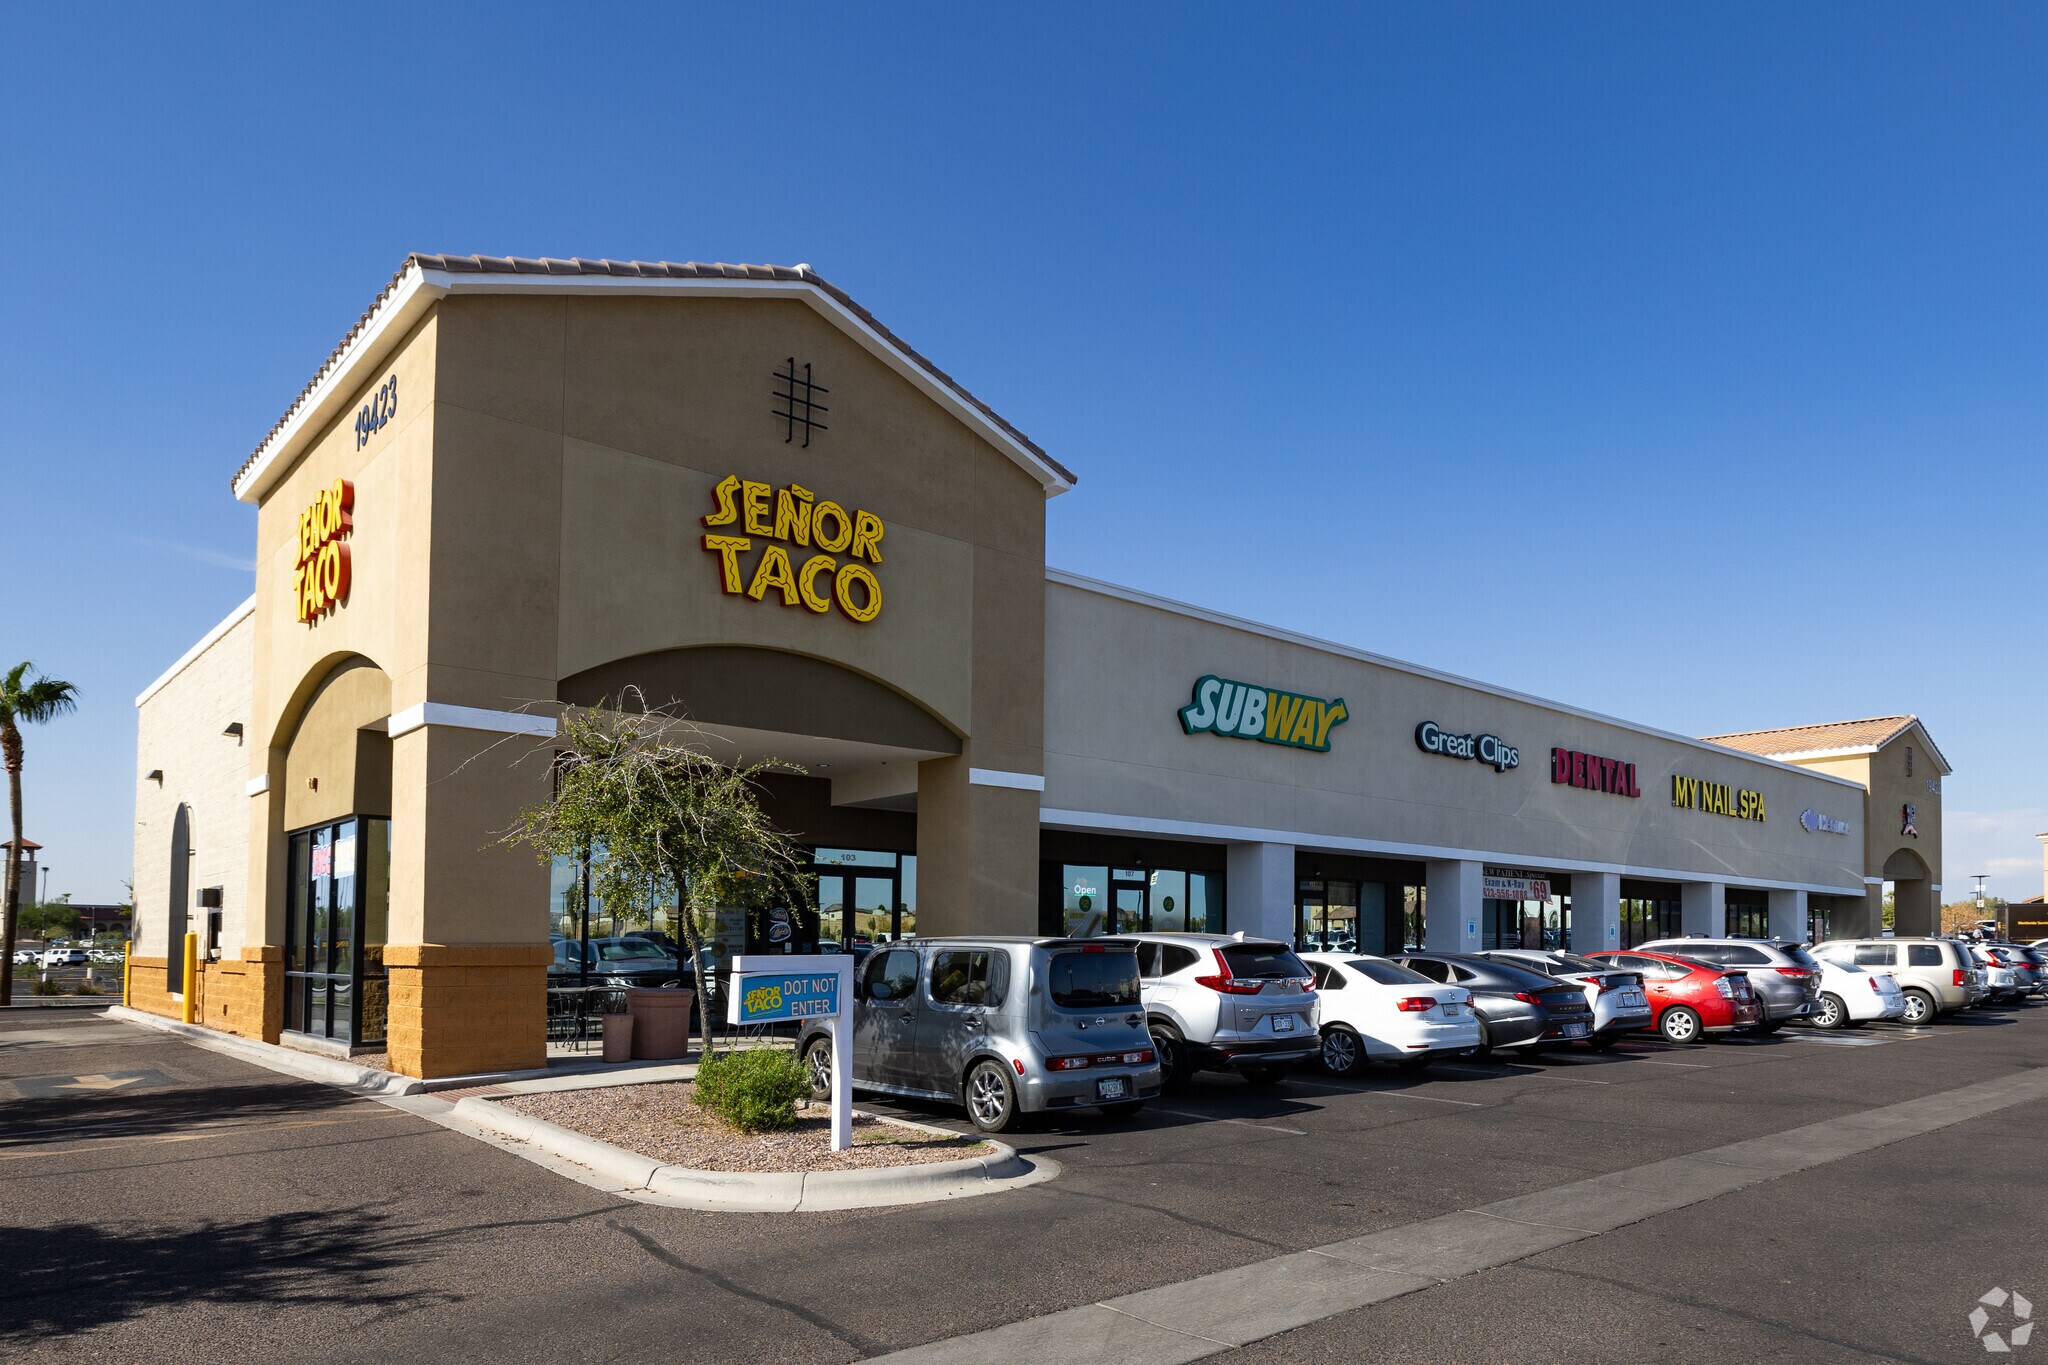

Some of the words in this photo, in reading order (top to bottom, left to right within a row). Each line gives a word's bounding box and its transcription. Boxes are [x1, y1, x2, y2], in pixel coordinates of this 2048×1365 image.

[355, 374, 397, 452] 19423
[294, 478, 352, 570] SEÑOR
[701, 474, 885, 564] SEÑOR
[294, 540, 349, 622] TACO
[701, 534, 883, 624] TACO
[1186, 675, 1348, 748] SUBWAY
[1421, 722, 1475, 758] Great
[1479, 735, 1519, 770] Clips
[1554, 747, 1640, 798] DENTAL
[1674, 775, 1699, 809] MY
[1702, 781, 1737, 817] NAIL
[1739, 789, 1766, 822] SPA
[841, 853, 856, 862] 103
[1496, 868, 1524, 878] PATIENT
[1074, 884, 1097, 896] Open
[1484, 878, 1500, 887] Exam
[1507, 879, 1525, 889] X-Ray
[743, 995, 783, 1013] TACO
[746, 986, 780, 1001] SEÑOR
[784, 979, 808, 996] DOT
[812, 977, 836, 993] NOT
[791, 999, 831, 1016] ENTER
